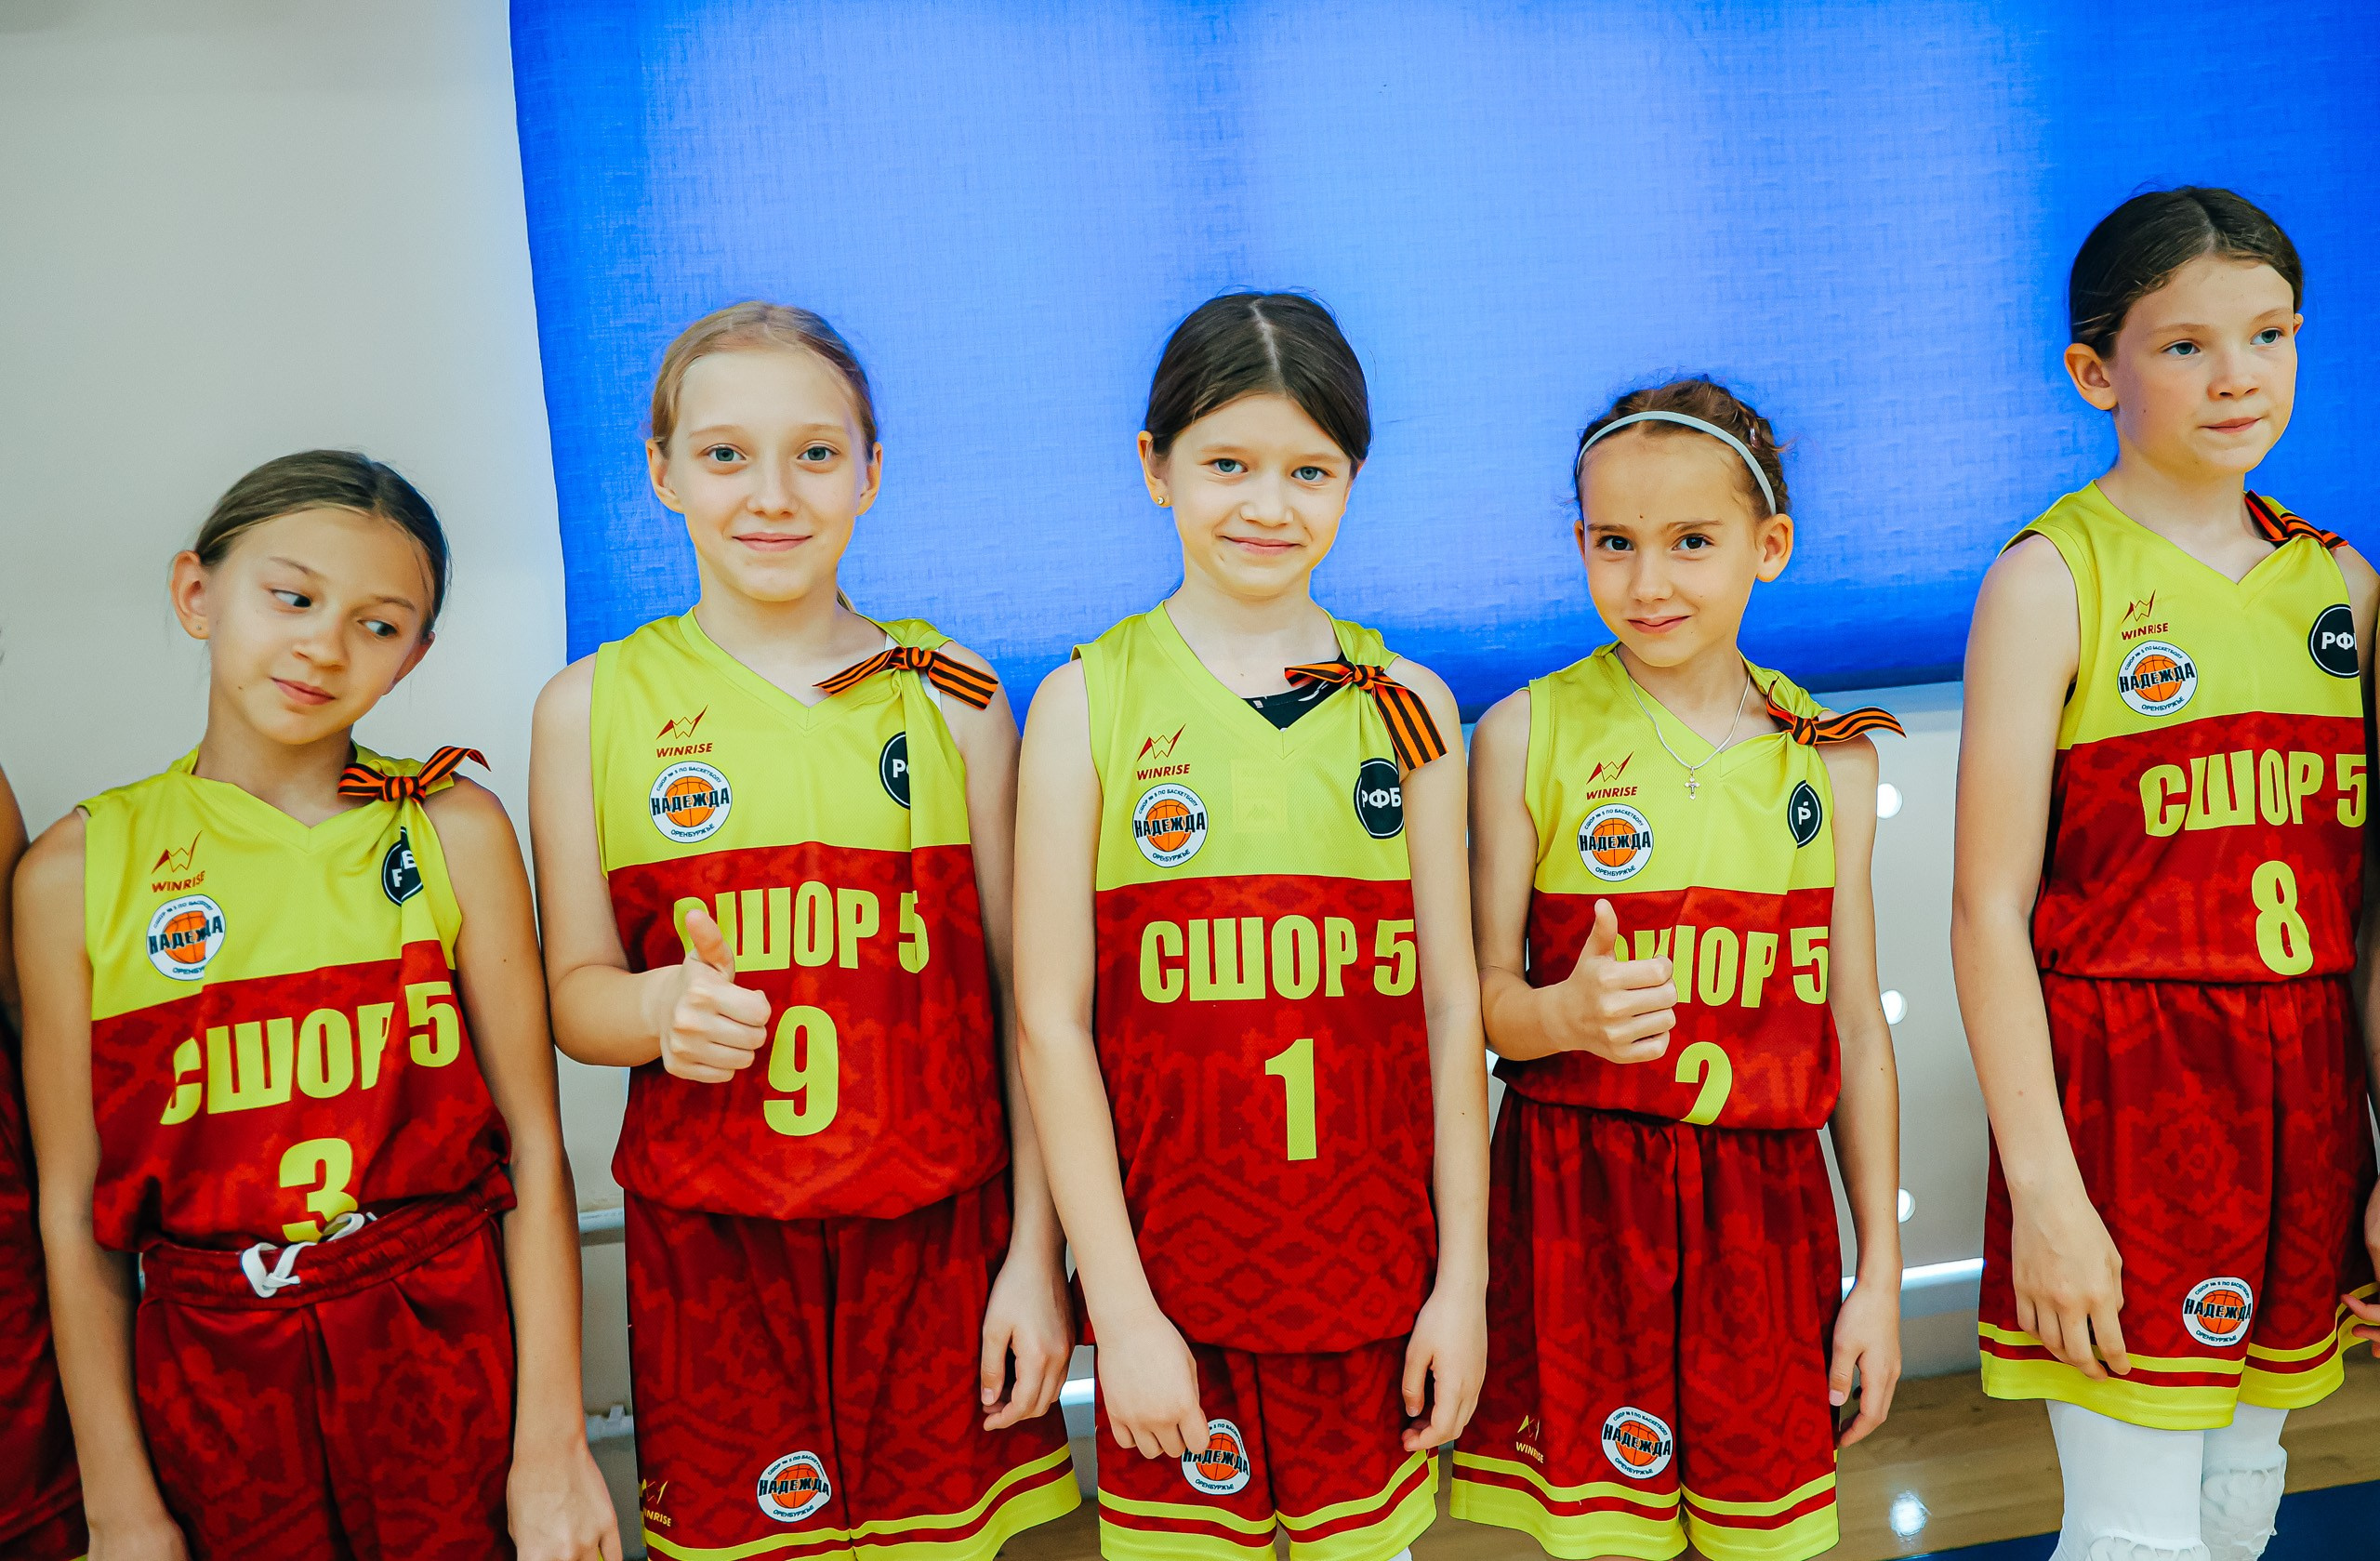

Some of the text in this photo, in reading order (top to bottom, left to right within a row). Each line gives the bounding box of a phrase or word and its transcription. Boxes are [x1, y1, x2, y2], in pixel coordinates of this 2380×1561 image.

[2122, 622, 2169, 641] WINRISE
[2321, 632, 2357, 650] РФ
[2120, 662, 2195, 694] НАДЕЖДА
[2141, 696, 2185, 711] ОРЕНБУРЖЬЕ
[656, 743, 713, 758] WINRISE
[1137, 763, 1191, 780] WINRISE
[651, 787, 730, 816] НАДЕЖДА
[1361, 787, 1402, 809] РФБ
[1586, 787, 1638, 800] WINRISE
[2140, 749, 2367, 837] СШОР 5
[670, 823, 715, 837] ОРЕНБУРЖЬЕ
[1134, 812, 1206, 838] НАДЕЖДА
[1580, 831, 1651, 852] НАДЕЖДА
[152, 870, 205, 893] WINRISE
[1595, 865, 1636, 877] ОРЕНБУРЖЬЕ
[2252, 860, 2313, 975] 8
[899, 891, 930, 973] 5
[1140, 915, 1417, 1003] СШОР 5
[1614, 926, 1829, 1008] ШОР 5
[160, 982, 460, 1125] СШОР 5
[763, 1005, 839, 1136] 9
[1675, 1041, 1732, 1125] 2
[1265, 1038, 1317, 1161] 1
[280, 1138, 358, 1244] 3
[2184, 1298, 2252, 1321] НАДЕЖДА
[1603, 1423, 1672, 1457] НАДЕЖДА
[1183, 1448, 1250, 1475] НАДЕЖДА
[759, 1478, 829, 1497] НАДЕЖДА
[643, 1507, 671, 1527] INRISE
